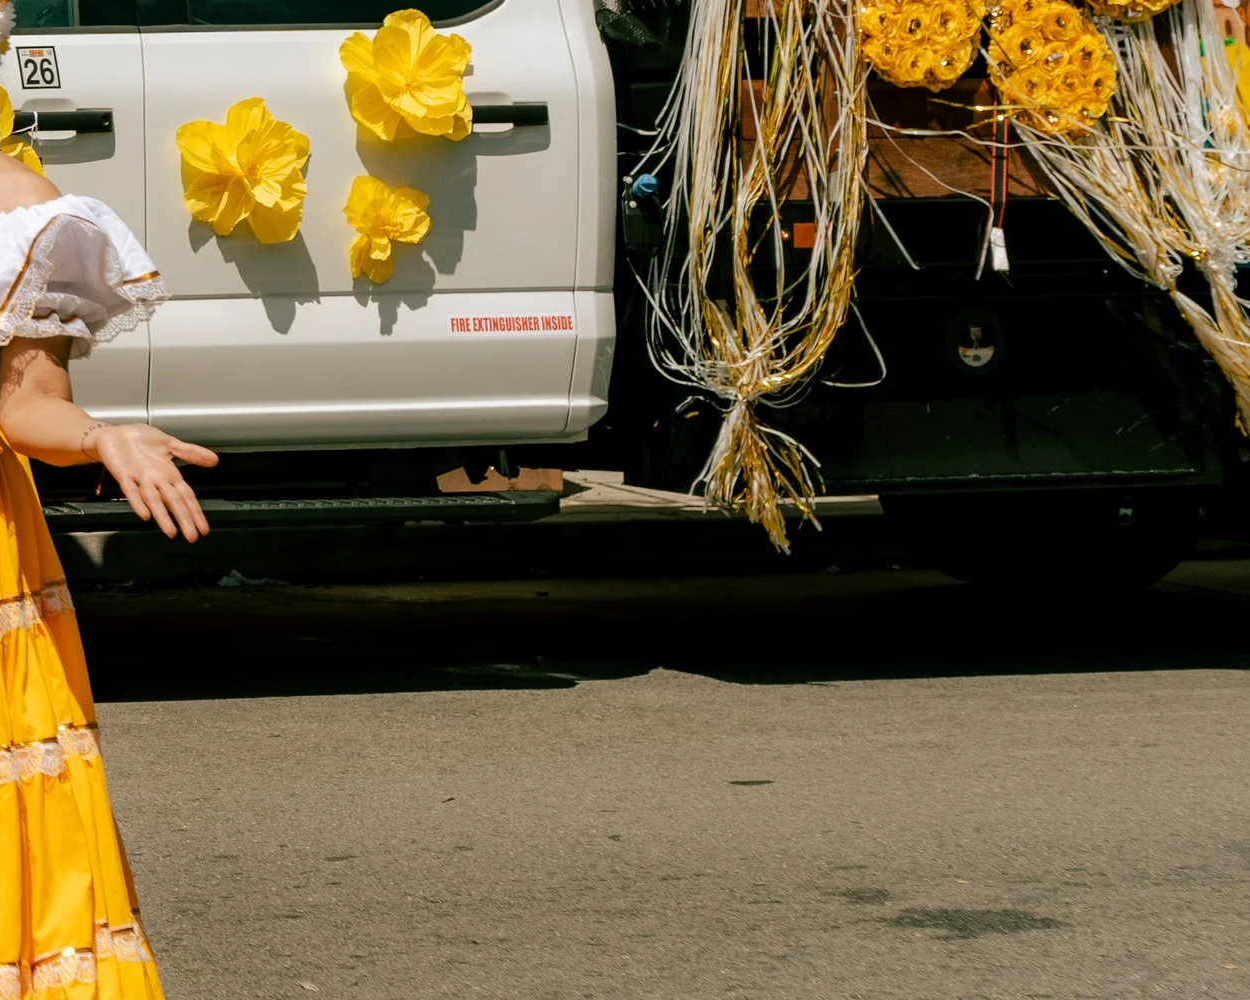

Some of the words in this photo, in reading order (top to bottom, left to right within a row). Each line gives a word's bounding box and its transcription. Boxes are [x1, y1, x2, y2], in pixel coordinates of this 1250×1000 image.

[23, 57, 55, 85] 26
[450, 317, 471, 333] FIRE
[472, 316, 540, 332] EXTINGUISHER
[541, 315, 574, 331] INSIDE
